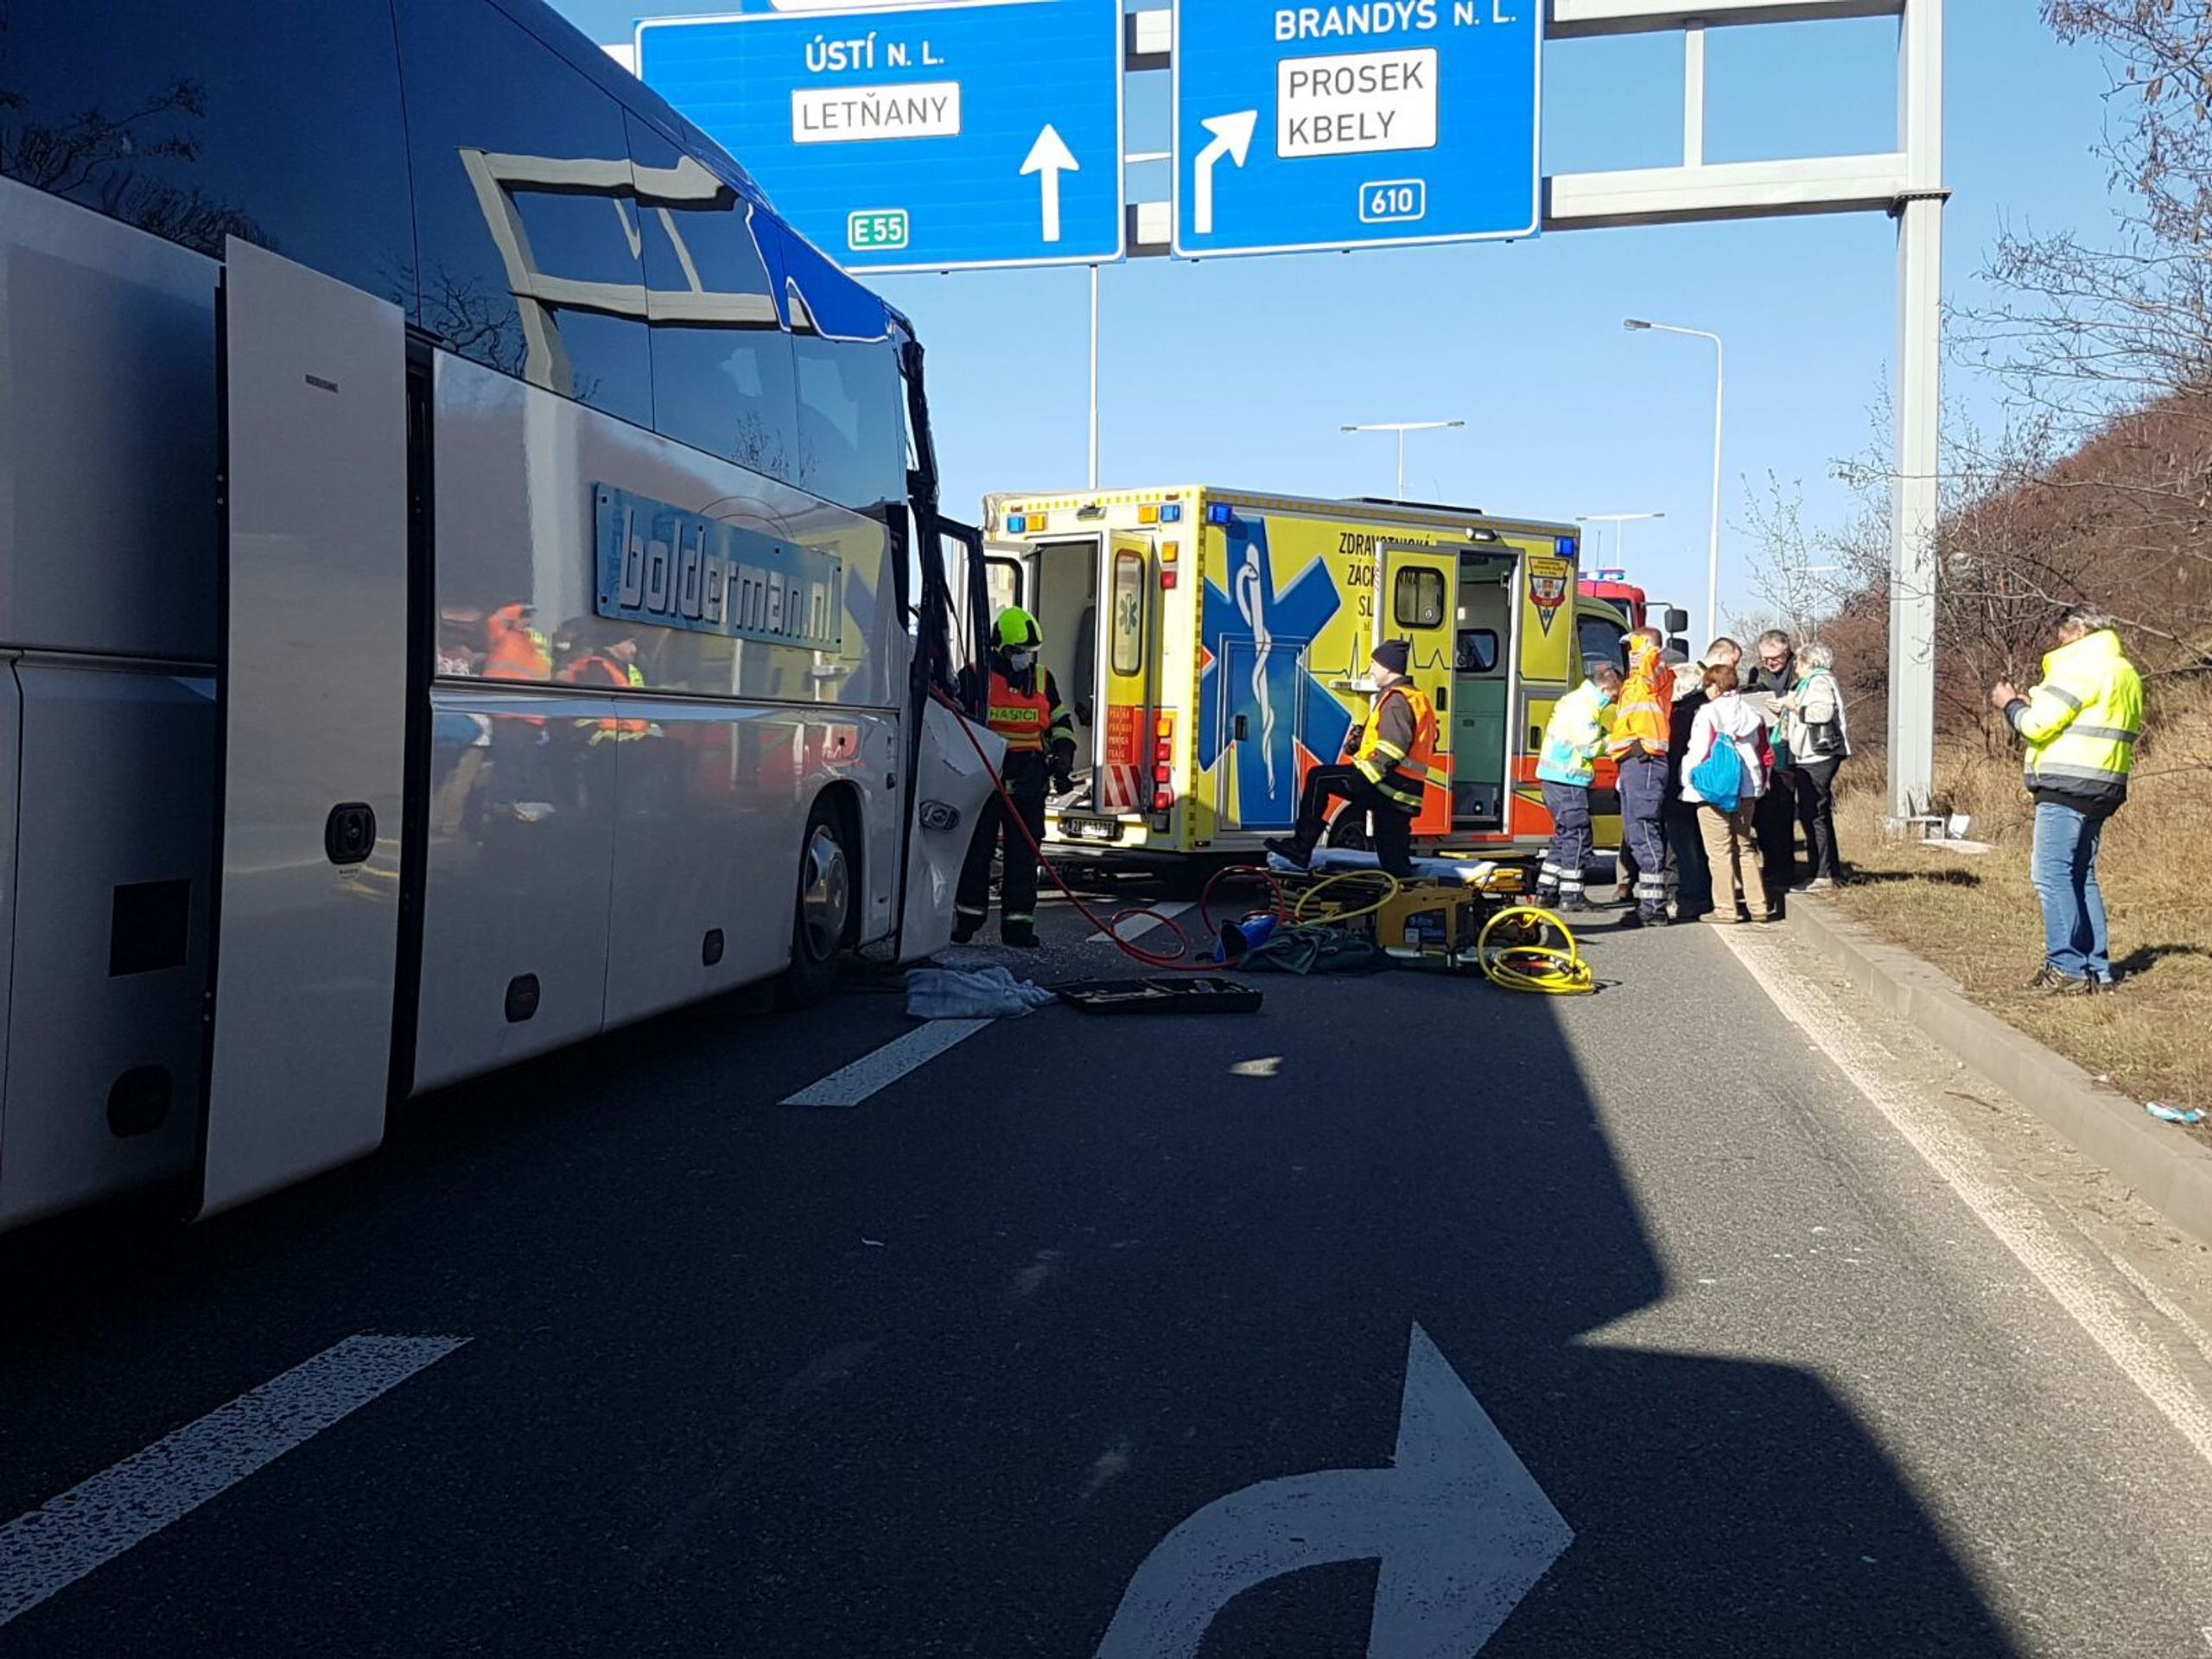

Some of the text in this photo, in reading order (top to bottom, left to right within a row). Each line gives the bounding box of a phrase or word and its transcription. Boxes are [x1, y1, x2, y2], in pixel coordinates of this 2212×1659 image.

[1453, 2, 1479, 26] N.
[1492, 0, 1516, 23] L.
[805, 31, 944, 73] ÚSTÍ N. L.
[1289, 61, 1424, 99] PROSEK
[804, 92, 948, 130] LETŇANY
[1288, 111, 1395, 145] KBELY
[1371, 188, 1413, 214] 610
[855, 217, 902, 242] E 55
